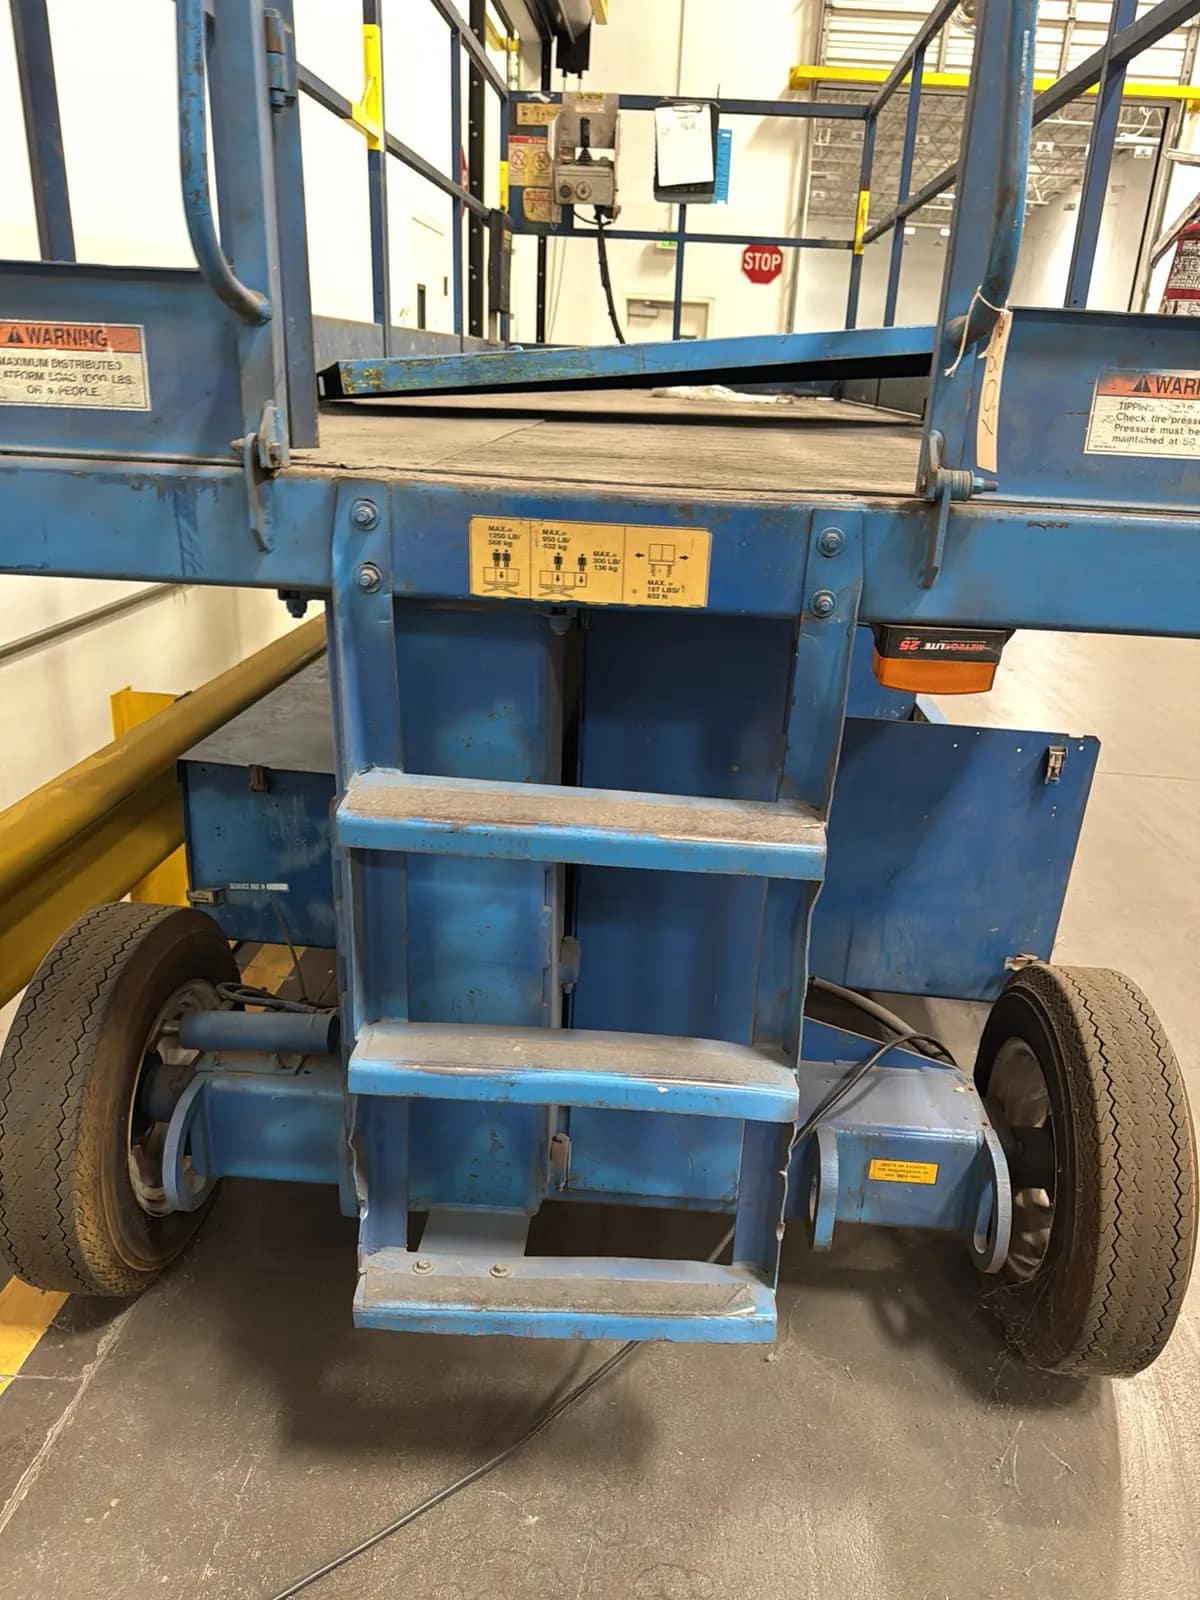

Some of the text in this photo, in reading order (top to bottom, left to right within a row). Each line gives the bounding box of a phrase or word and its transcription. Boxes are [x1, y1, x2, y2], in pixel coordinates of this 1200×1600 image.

[743, 252, 781, 272] STOP
[26, 326, 108, 348] WARNING
[51, 358, 122, 371] DISTRIBUTED
[1156, 375, 1200, 396] WAR
[1115, 411, 1147, 423] Check
[1114, 423, 1156, 434] Pressure
[1159, 427, 1185, 436] must
[1111, 435, 1165, 445] maintained
[1168, 437, 1179, 445] at
[503, 540, 513, 548] kg
[558, 543, 568, 551] kg
[898, 639, 921, 651] 25
